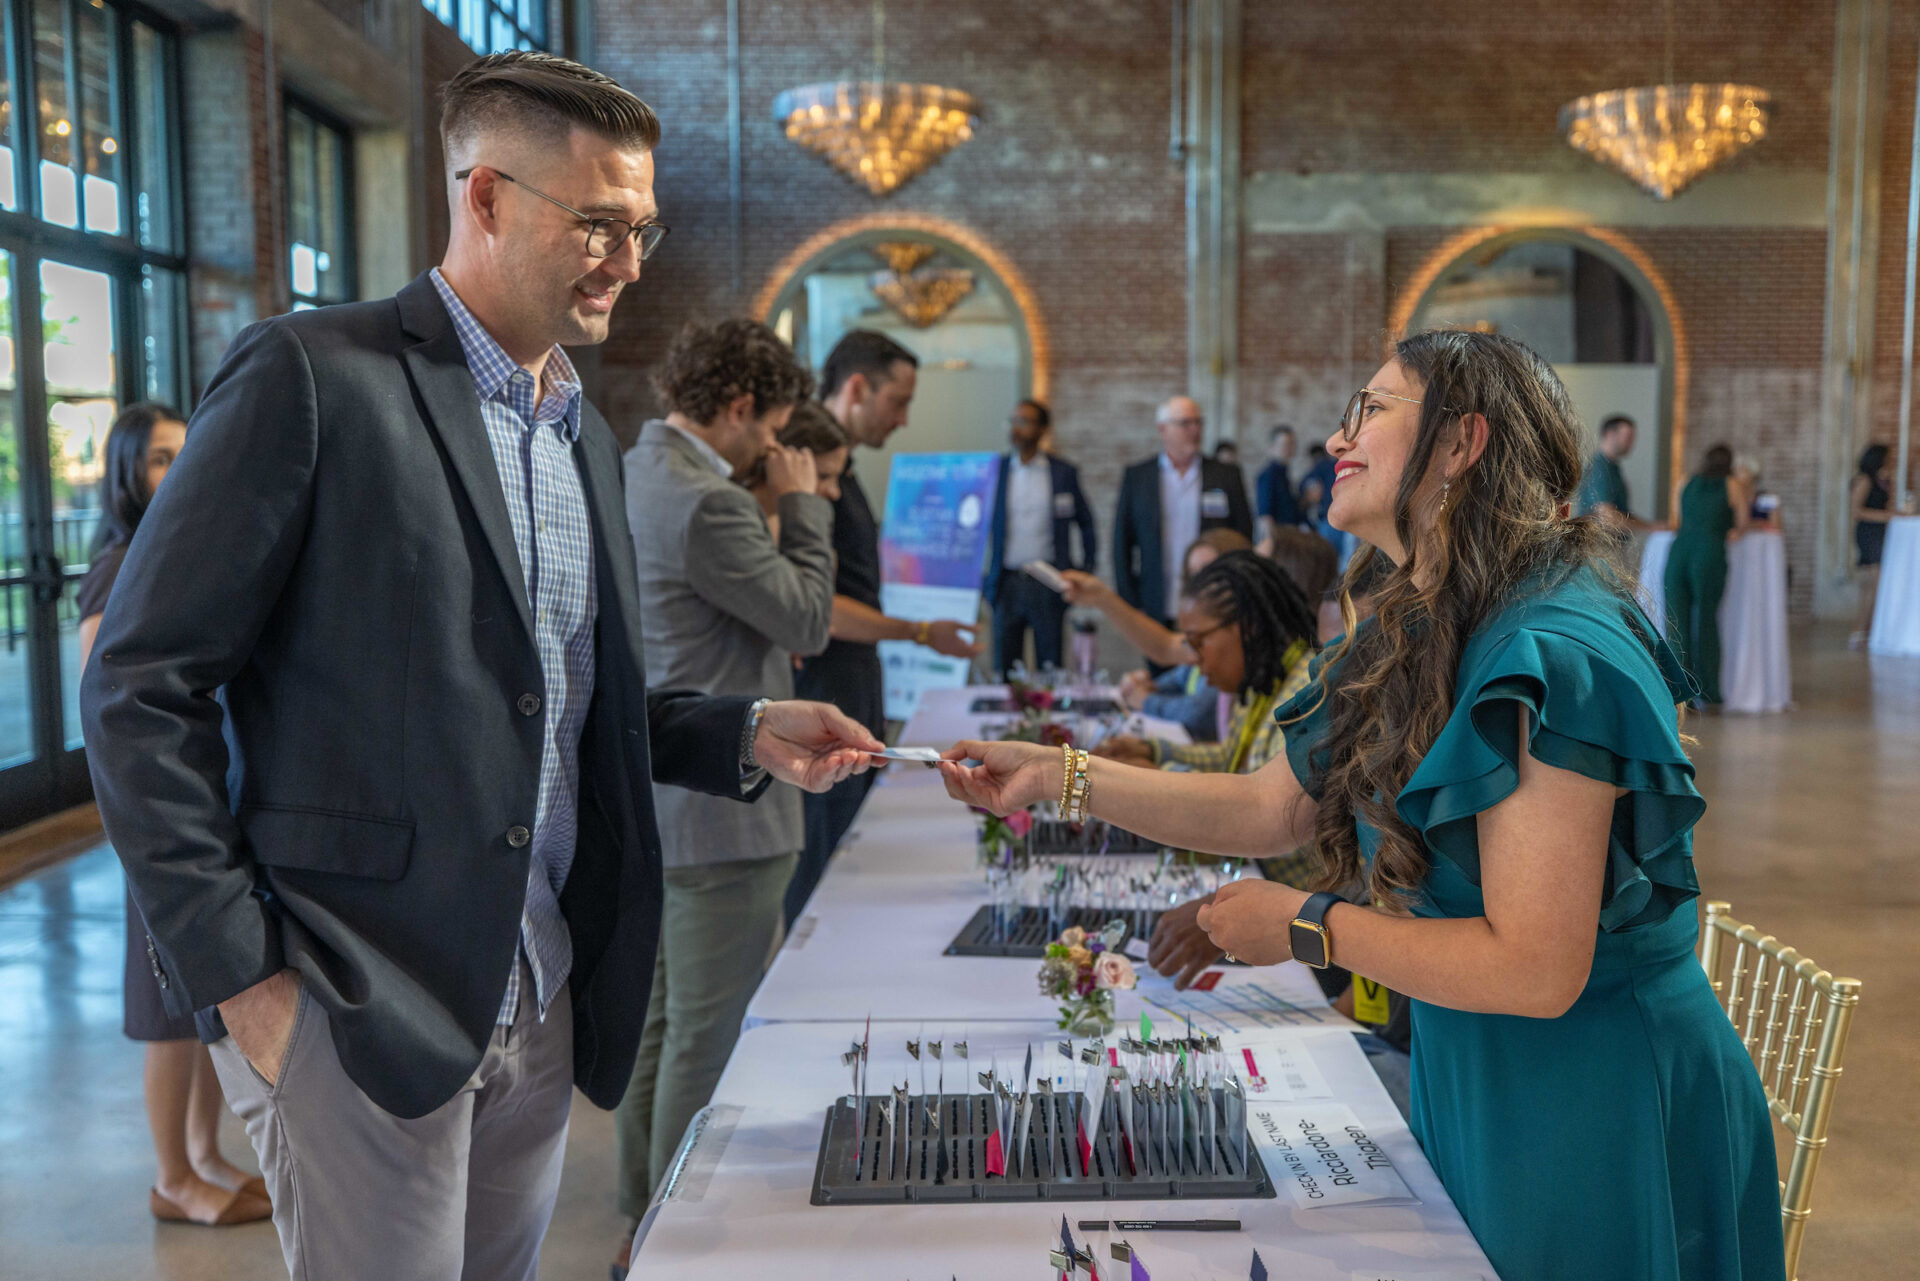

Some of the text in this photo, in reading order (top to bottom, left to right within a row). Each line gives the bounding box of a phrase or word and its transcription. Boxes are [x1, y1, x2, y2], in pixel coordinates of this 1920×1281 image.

[1256, 1112, 1280, 1133] NAME
[1269, 1134, 1293, 1151] LAST
[1298, 1118, 1359, 1186] Ricciardone-
[1281, 1152, 1300, 1162] BY
[1288, 1163, 1306, 1172] IN
[1294, 1171, 1324, 1199] CHECK
